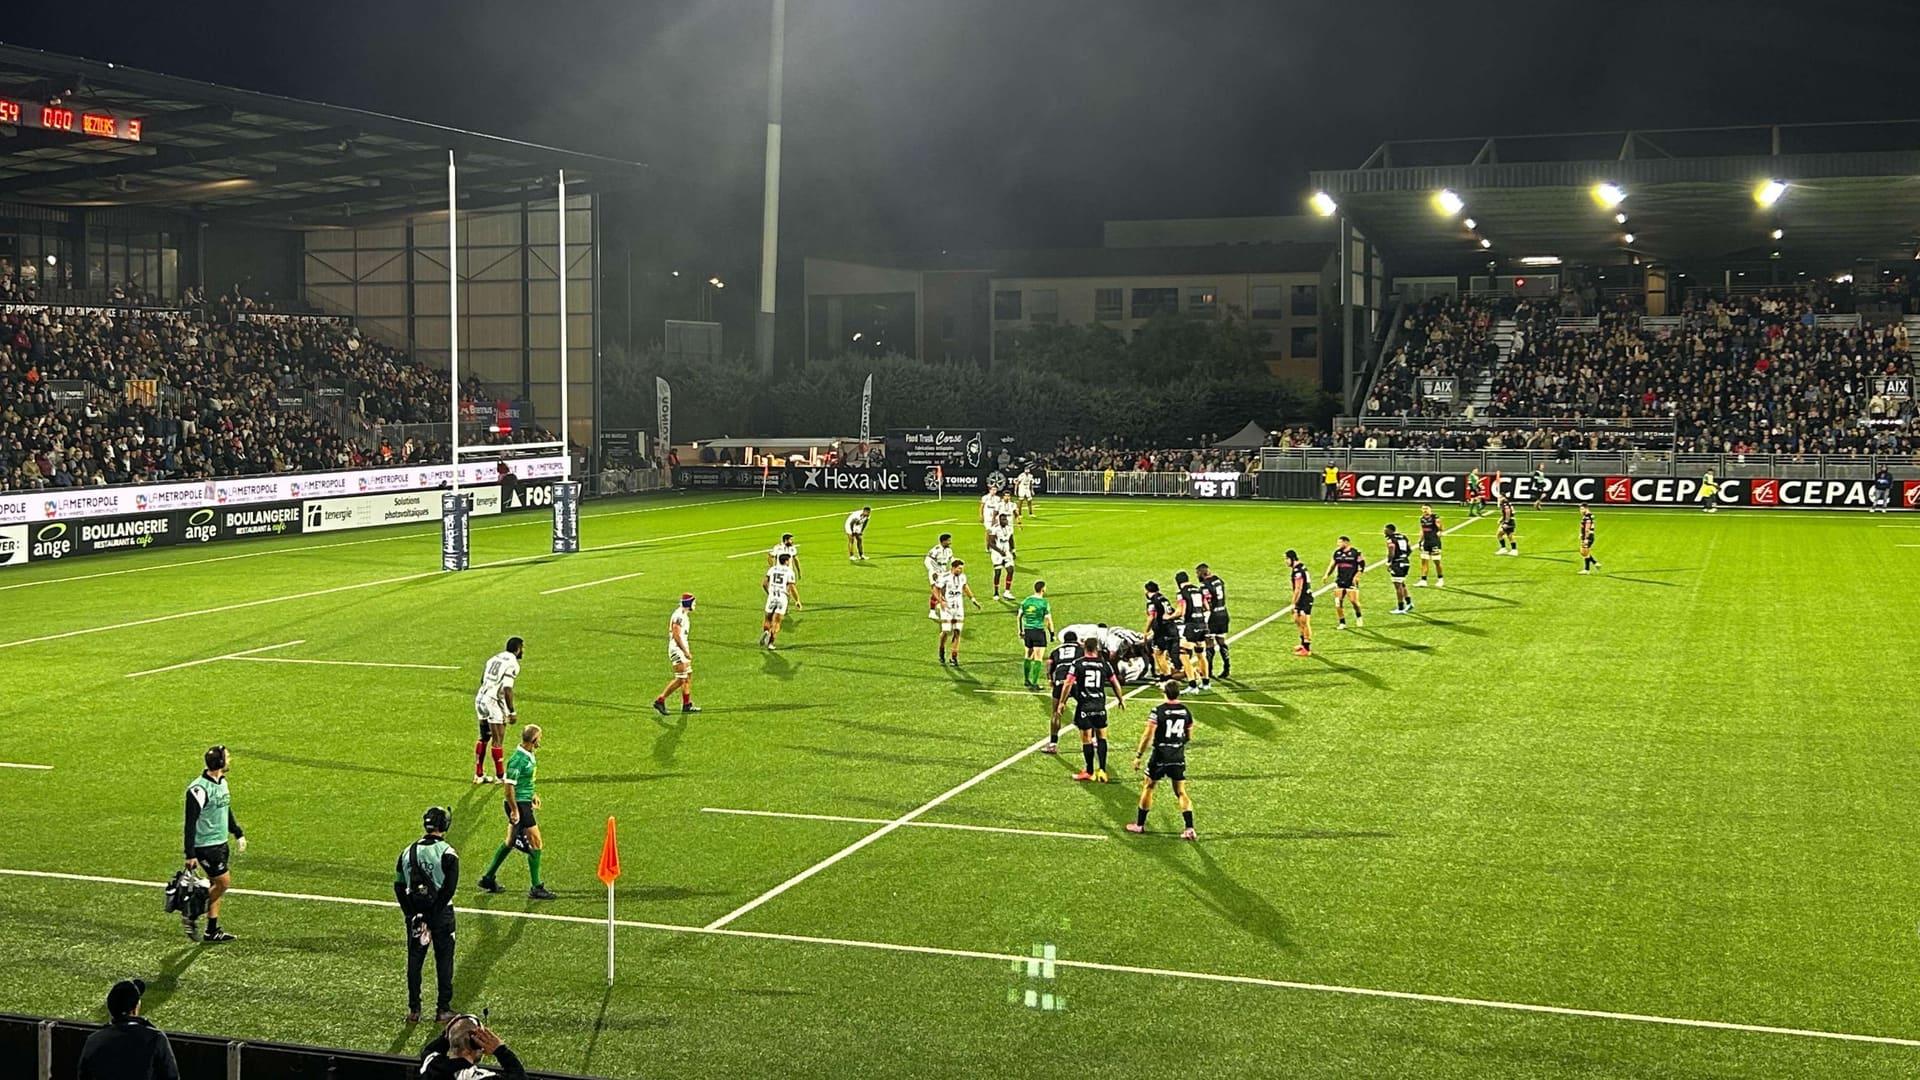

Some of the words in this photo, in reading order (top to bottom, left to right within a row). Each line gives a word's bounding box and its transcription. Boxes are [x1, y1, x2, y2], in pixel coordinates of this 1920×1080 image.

[1433, 381, 1453, 393] AIX
[1886, 380, 1907, 393] AIX
[945, 476, 978, 484] TOINOU
[1355, 474, 1456, 498] CEPAC
[1631, 479, 1740, 502] CEPC
[394, 496, 420, 506] Solutions
[226, 508, 300, 527] BOULANGERIE
[82, 518, 169, 541] BOULANGERIE
[185, 524, 217, 542] ange
[236, 525, 266, 535] RESTAURANT
[33, 539, 71, 558] ange
[93, 537, 130, 550] RESTAURANT
[773, 572, 785, 585] 15
[1084, 669, 1102, 688] 21
[1165, 718, 1185, 738] 14
